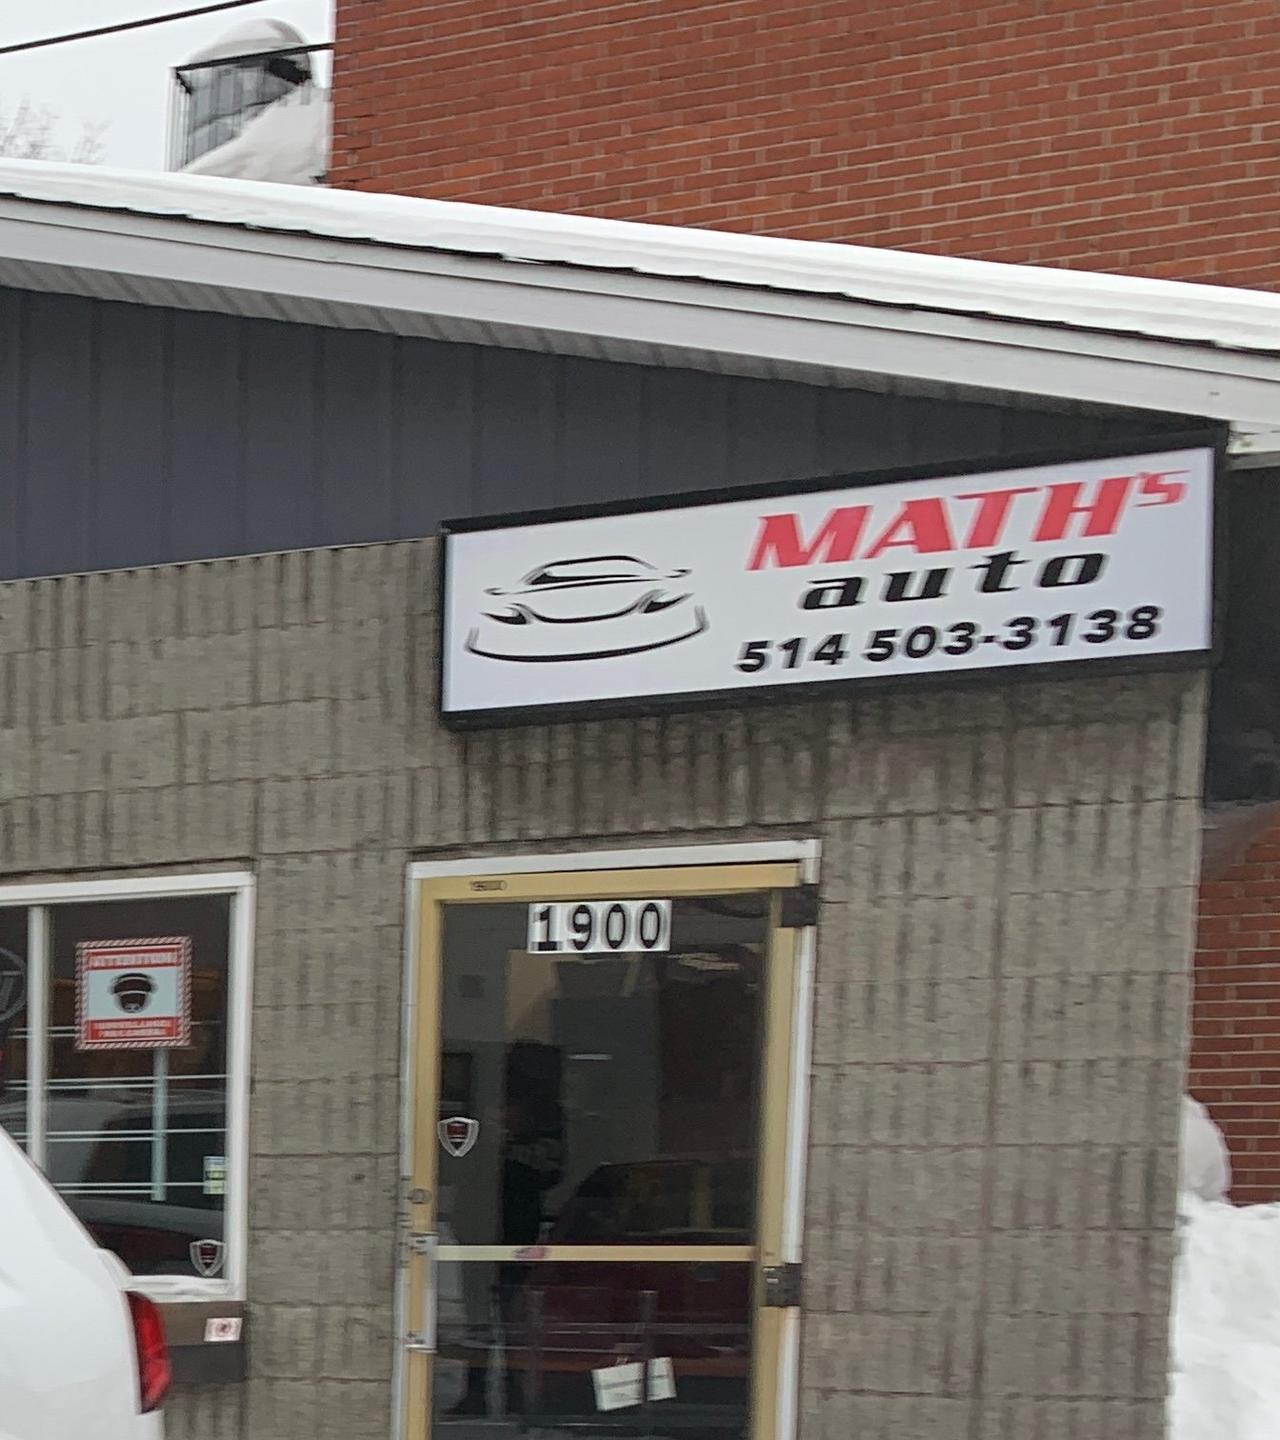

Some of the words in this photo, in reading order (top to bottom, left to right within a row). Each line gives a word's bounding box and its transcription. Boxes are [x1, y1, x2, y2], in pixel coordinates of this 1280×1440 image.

[801, 550, 1108, 611] auto
[737, 631, 845, 673] 514
[866, 605, 1162, 665] 503-3138
[534, 902, 661, 950] 1900
